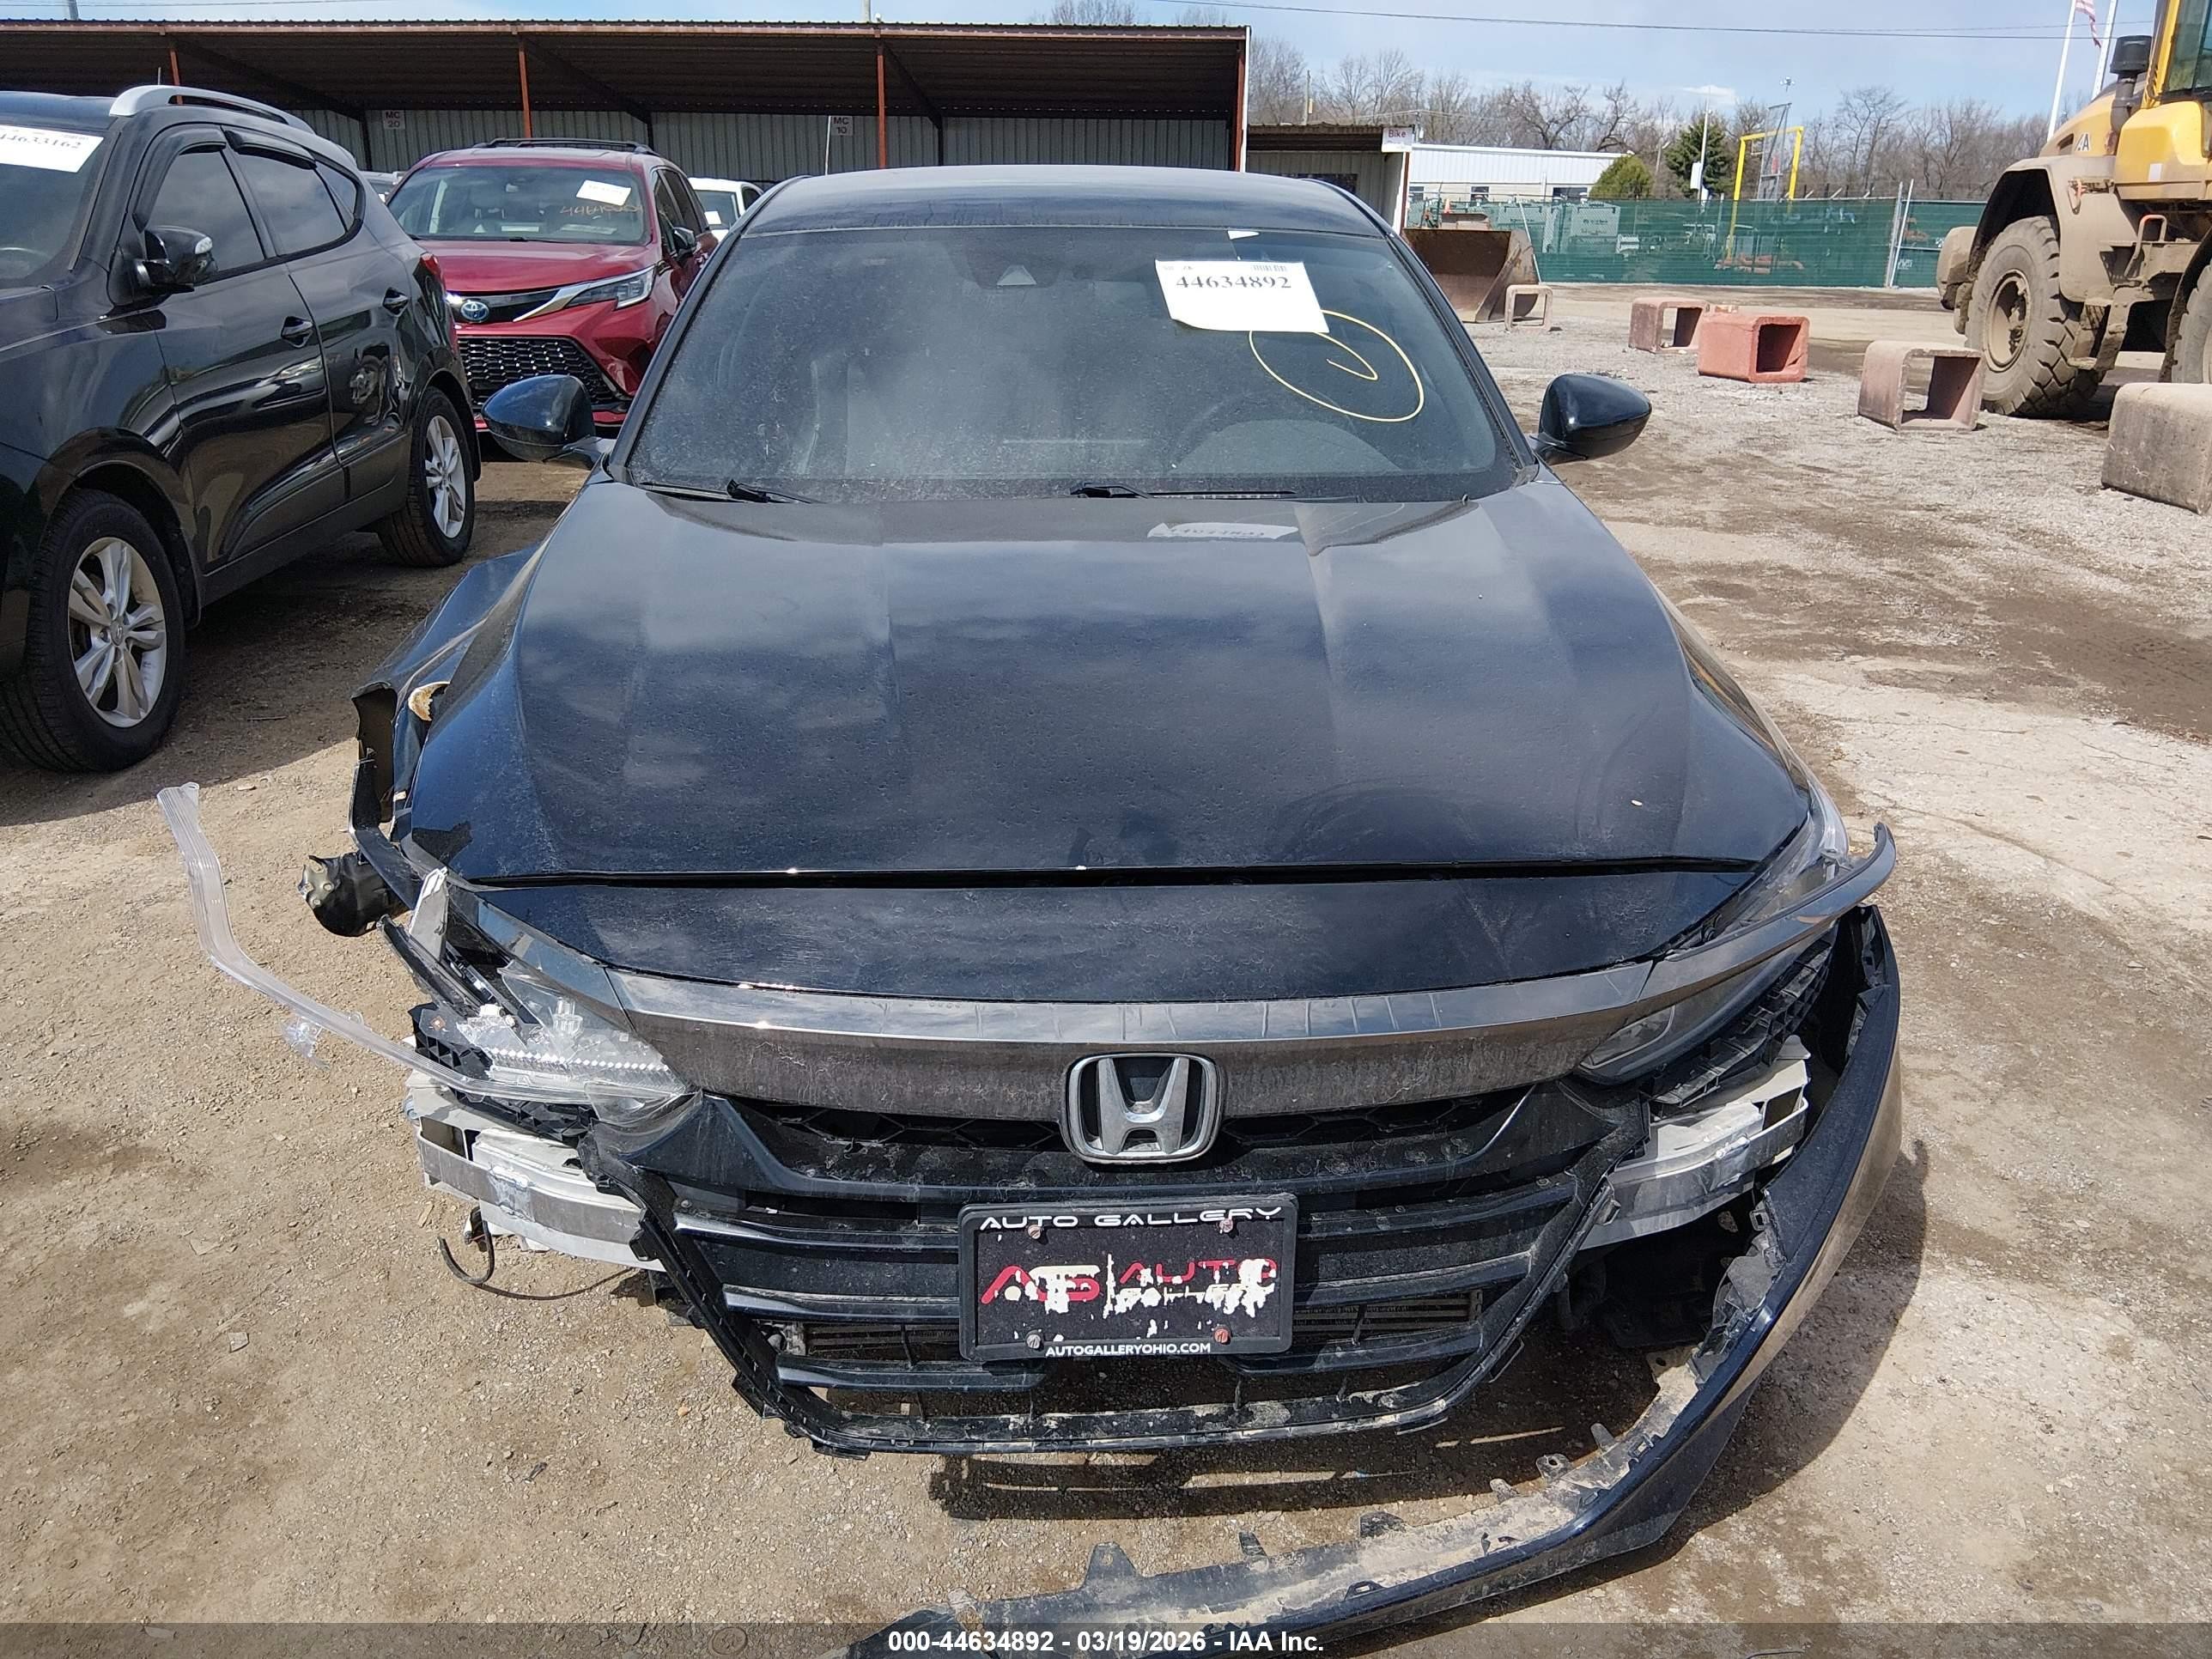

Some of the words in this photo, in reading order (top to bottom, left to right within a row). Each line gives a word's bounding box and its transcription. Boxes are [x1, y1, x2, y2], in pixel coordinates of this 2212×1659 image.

[1176, 274, 1291, 289] 44634892
[980, 1215, 1079, 1231] AUTO
[1094, 1206, 1282, 1227] GALLERY
[1045, 1342, 1212, 1358] AUTOGALLERYOHIO.COM
